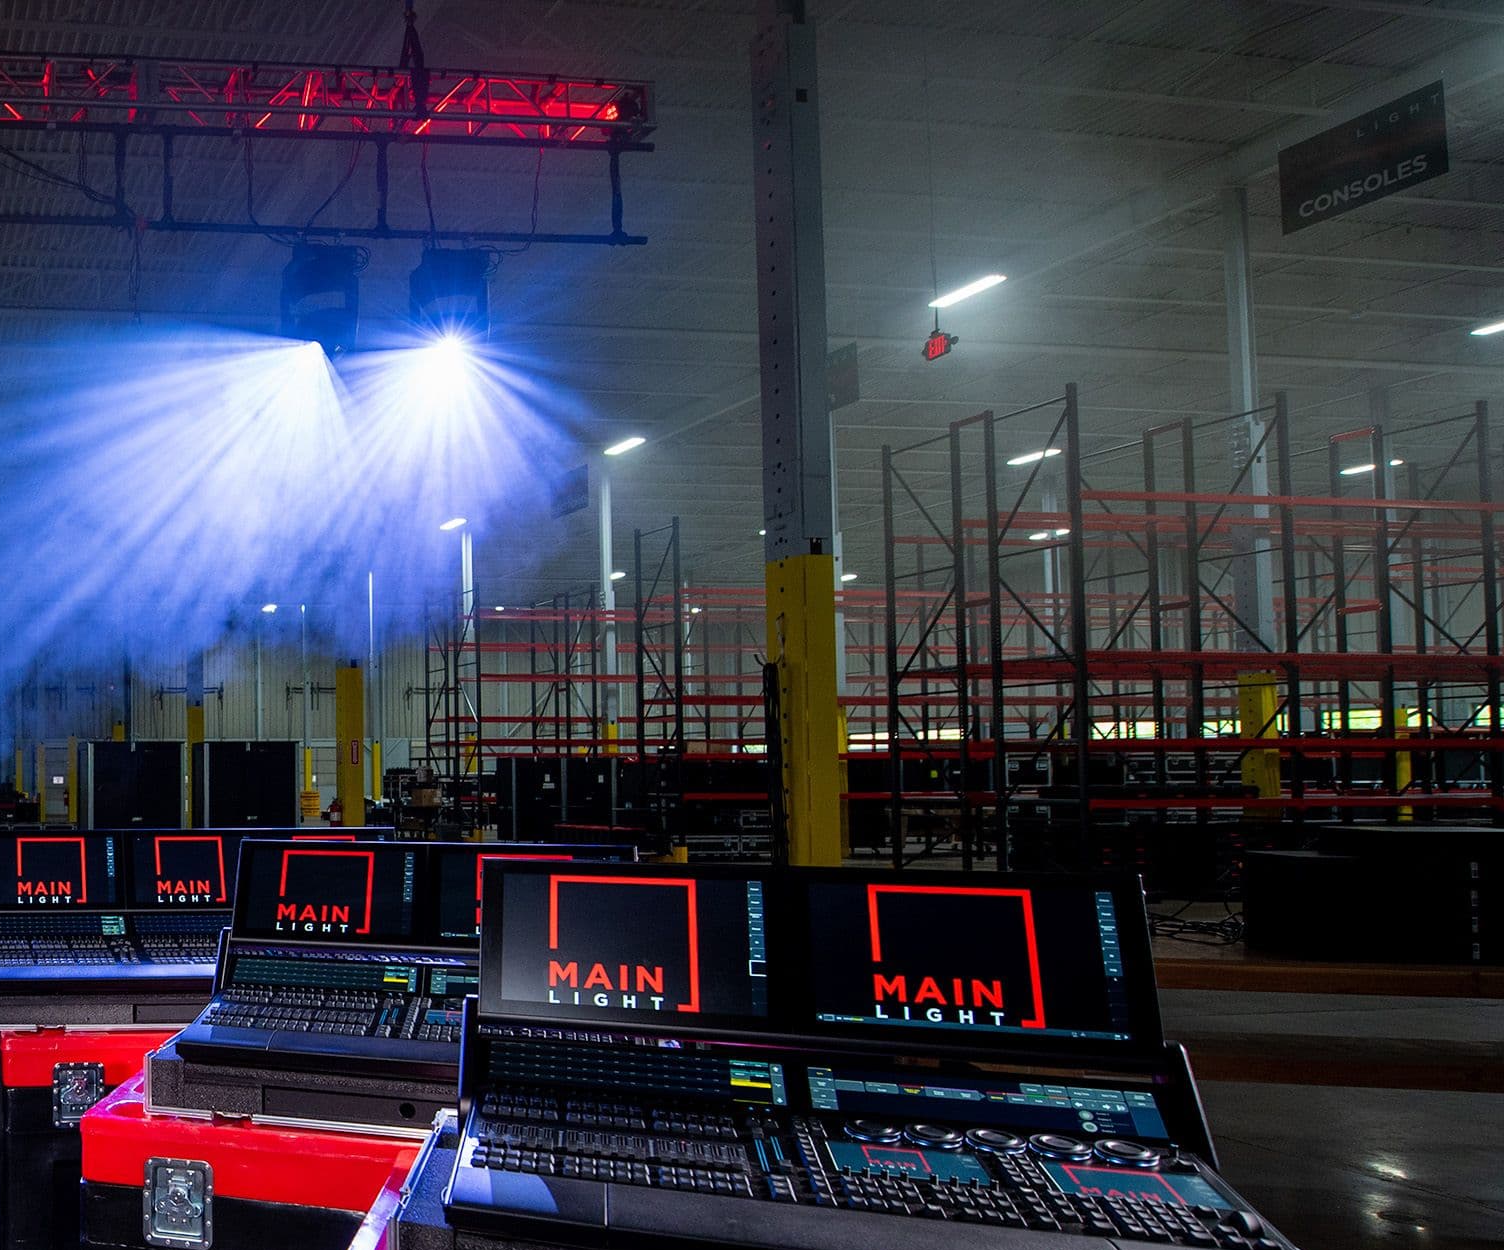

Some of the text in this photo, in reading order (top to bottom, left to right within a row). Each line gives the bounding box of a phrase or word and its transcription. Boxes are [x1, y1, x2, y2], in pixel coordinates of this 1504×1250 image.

[1298, 153, 1429, 218] CONSOLES
[17, 881, 72, 896] MAIN
[156, 879, 211, 895] MAIN
[17, 895, 72, 904] LIGHT
[156, 894, 211, 903] LIGHT
[276, 903, 350, 923] MAIN
[275, 921, 349, 933] LIGHT
[548, 960, 664, 994] MAIN
[548, 989, 664, 1011] LIGHT
[873, 973, 1004, 1009] MAIN
[875, 1004, 1005, 1026] LIGHT
